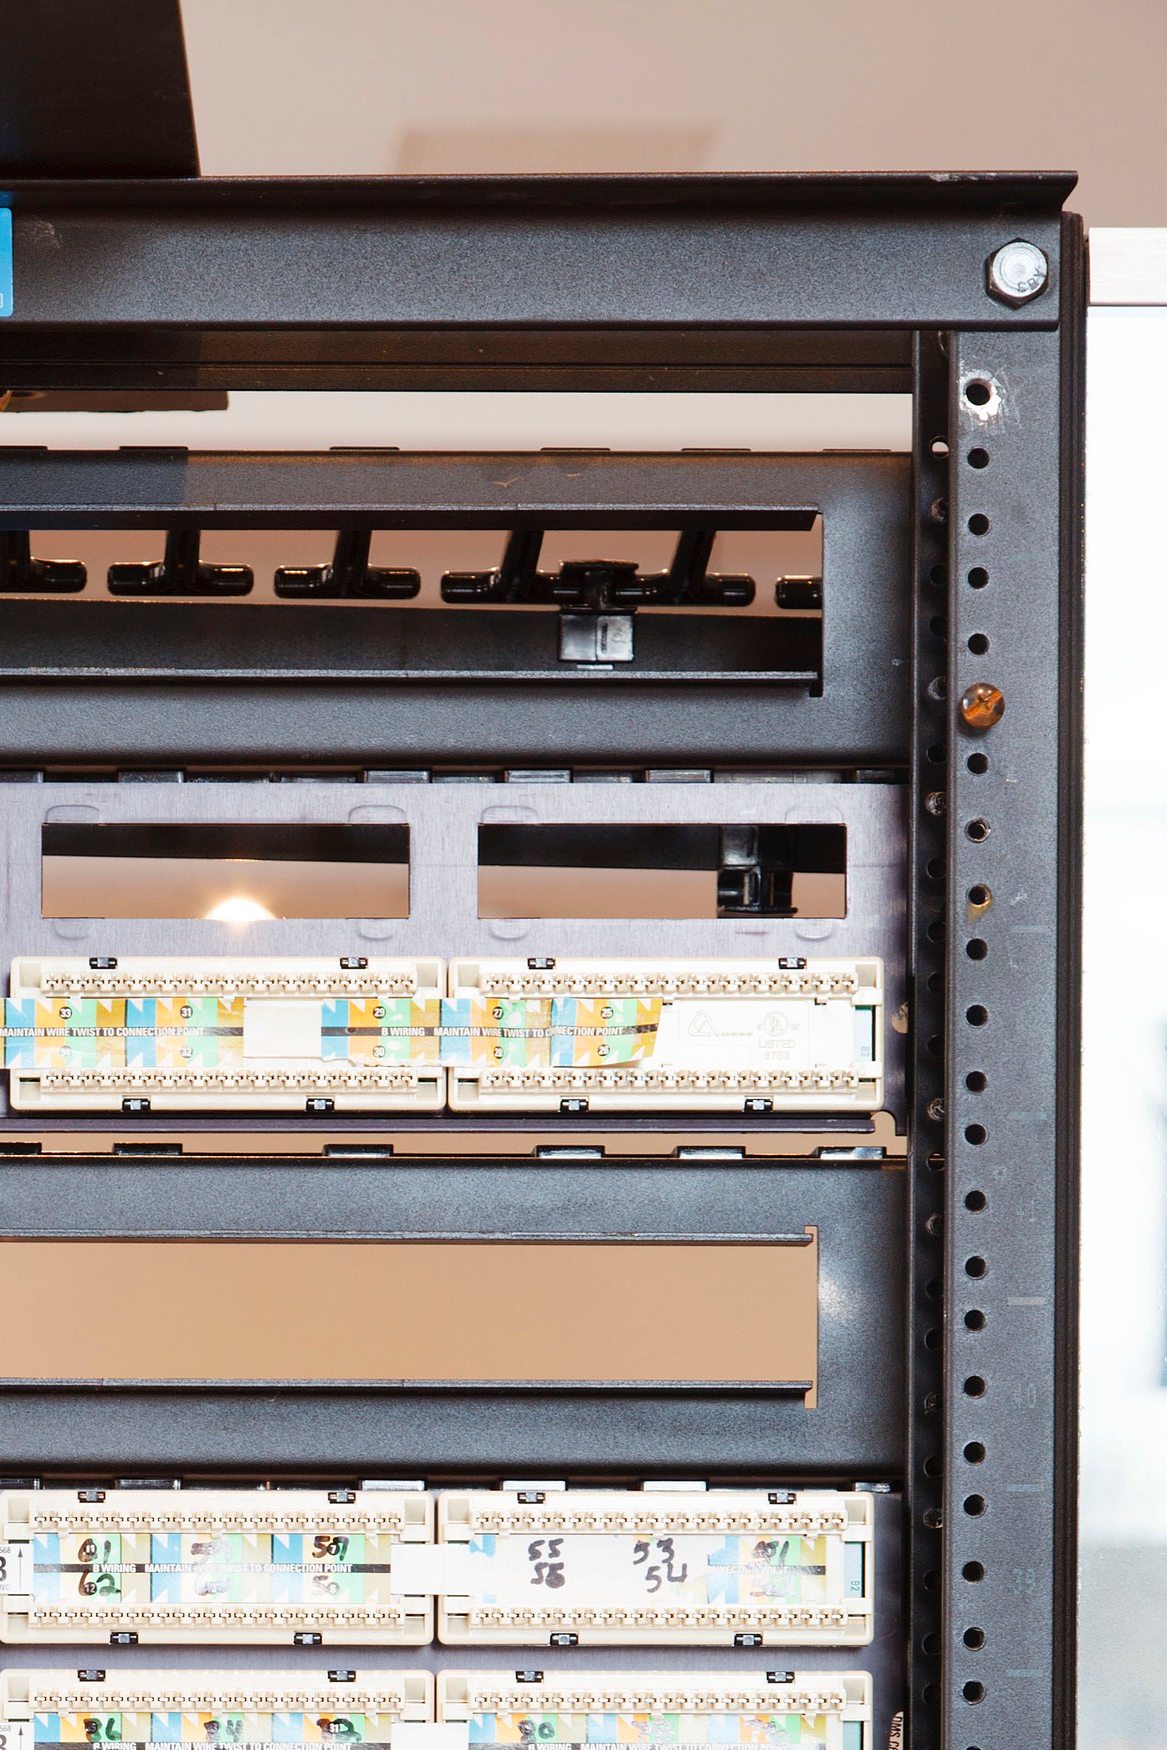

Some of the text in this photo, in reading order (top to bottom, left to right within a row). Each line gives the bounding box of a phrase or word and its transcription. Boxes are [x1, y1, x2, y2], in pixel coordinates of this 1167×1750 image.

[0, 1028, 204, 1036] MAINTAIN WIRE TWIST TO CONNECTION POINT
[390, 1027, 425, 1036] WIRING
[434, 1027, 481, 1036] MAINTAIN
[482, 1028, 502, 1037] WIRE
[503, 1028, 530, 1038] TWIST
[596, 1026, 623, 1036] POINT
[528, 1538, 564, 1562] 55
[633, 1538, 674, 1565] 53
